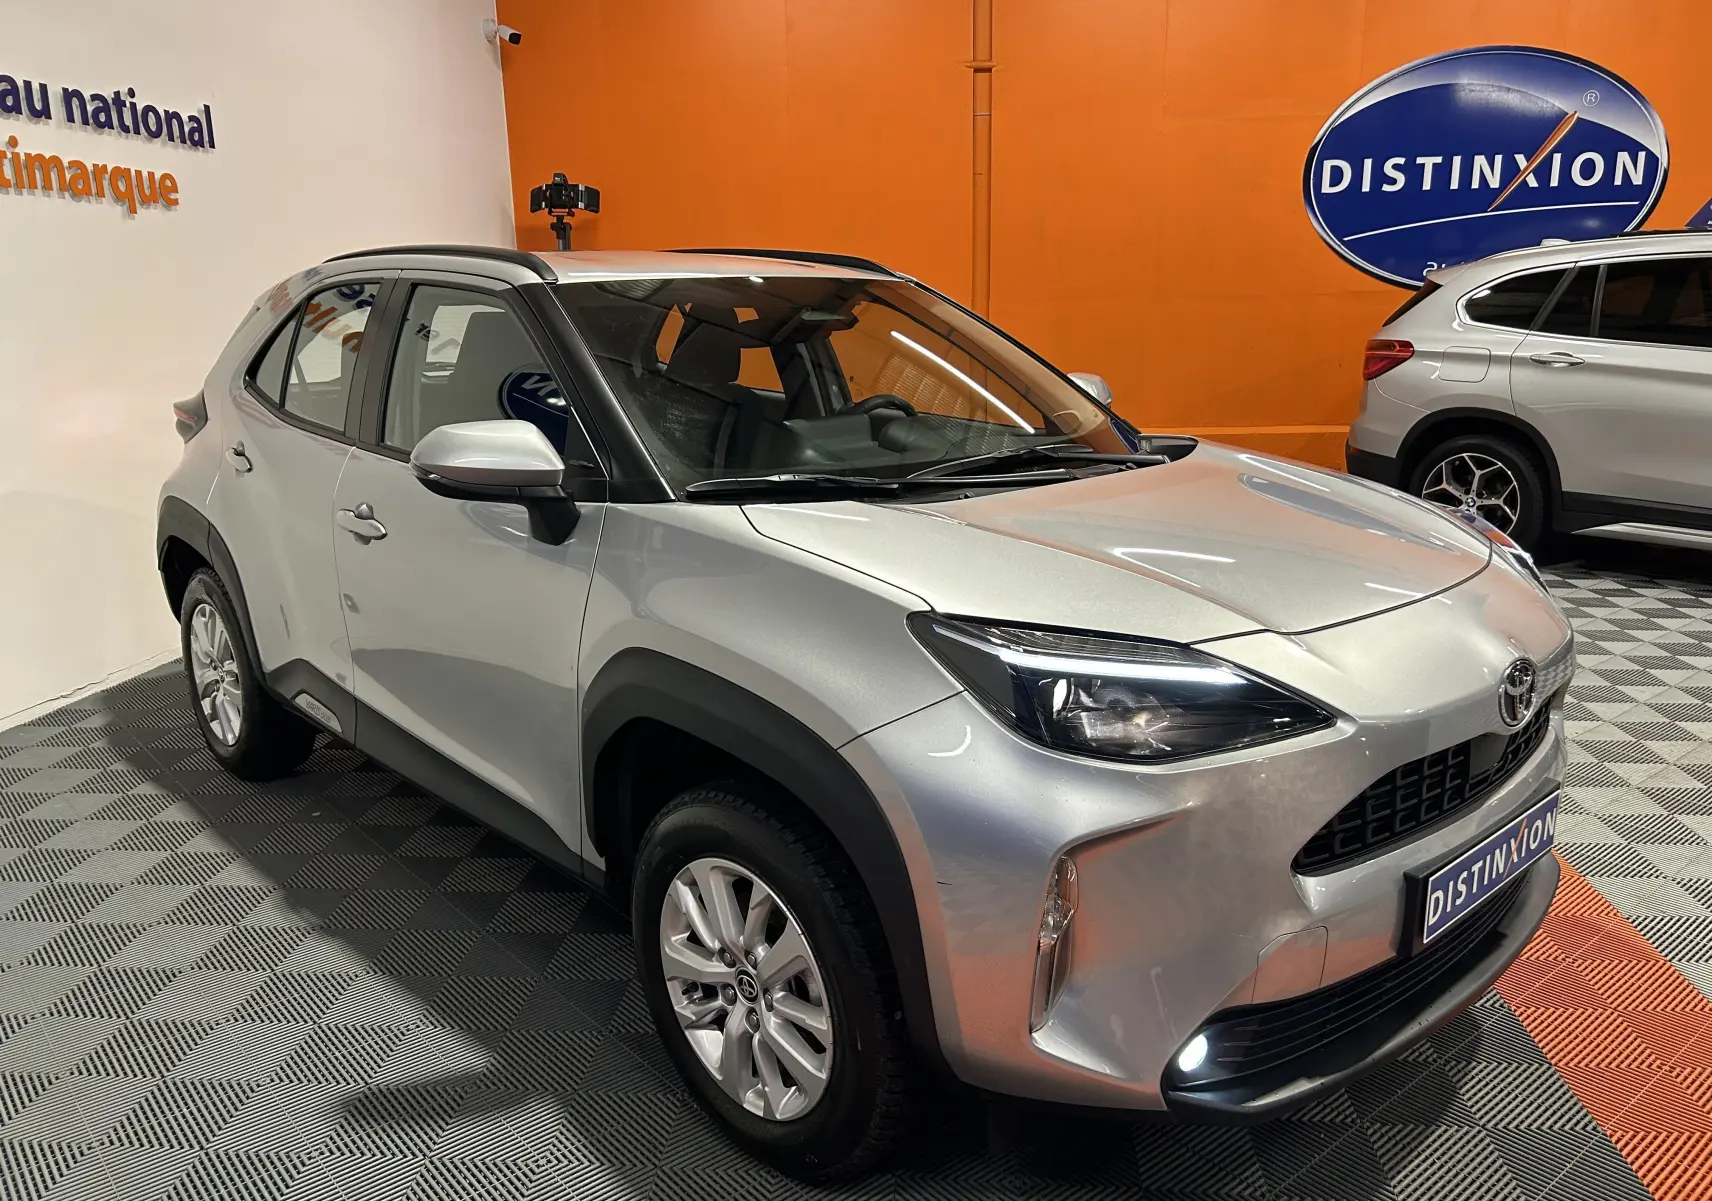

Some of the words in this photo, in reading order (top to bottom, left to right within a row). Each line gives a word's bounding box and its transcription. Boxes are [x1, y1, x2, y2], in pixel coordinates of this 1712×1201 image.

[62, 87, 216, 149] national
[1321, 150, 1647, 194] DISTINXION
[1428, 807, 1557, 926] DISTINXION
